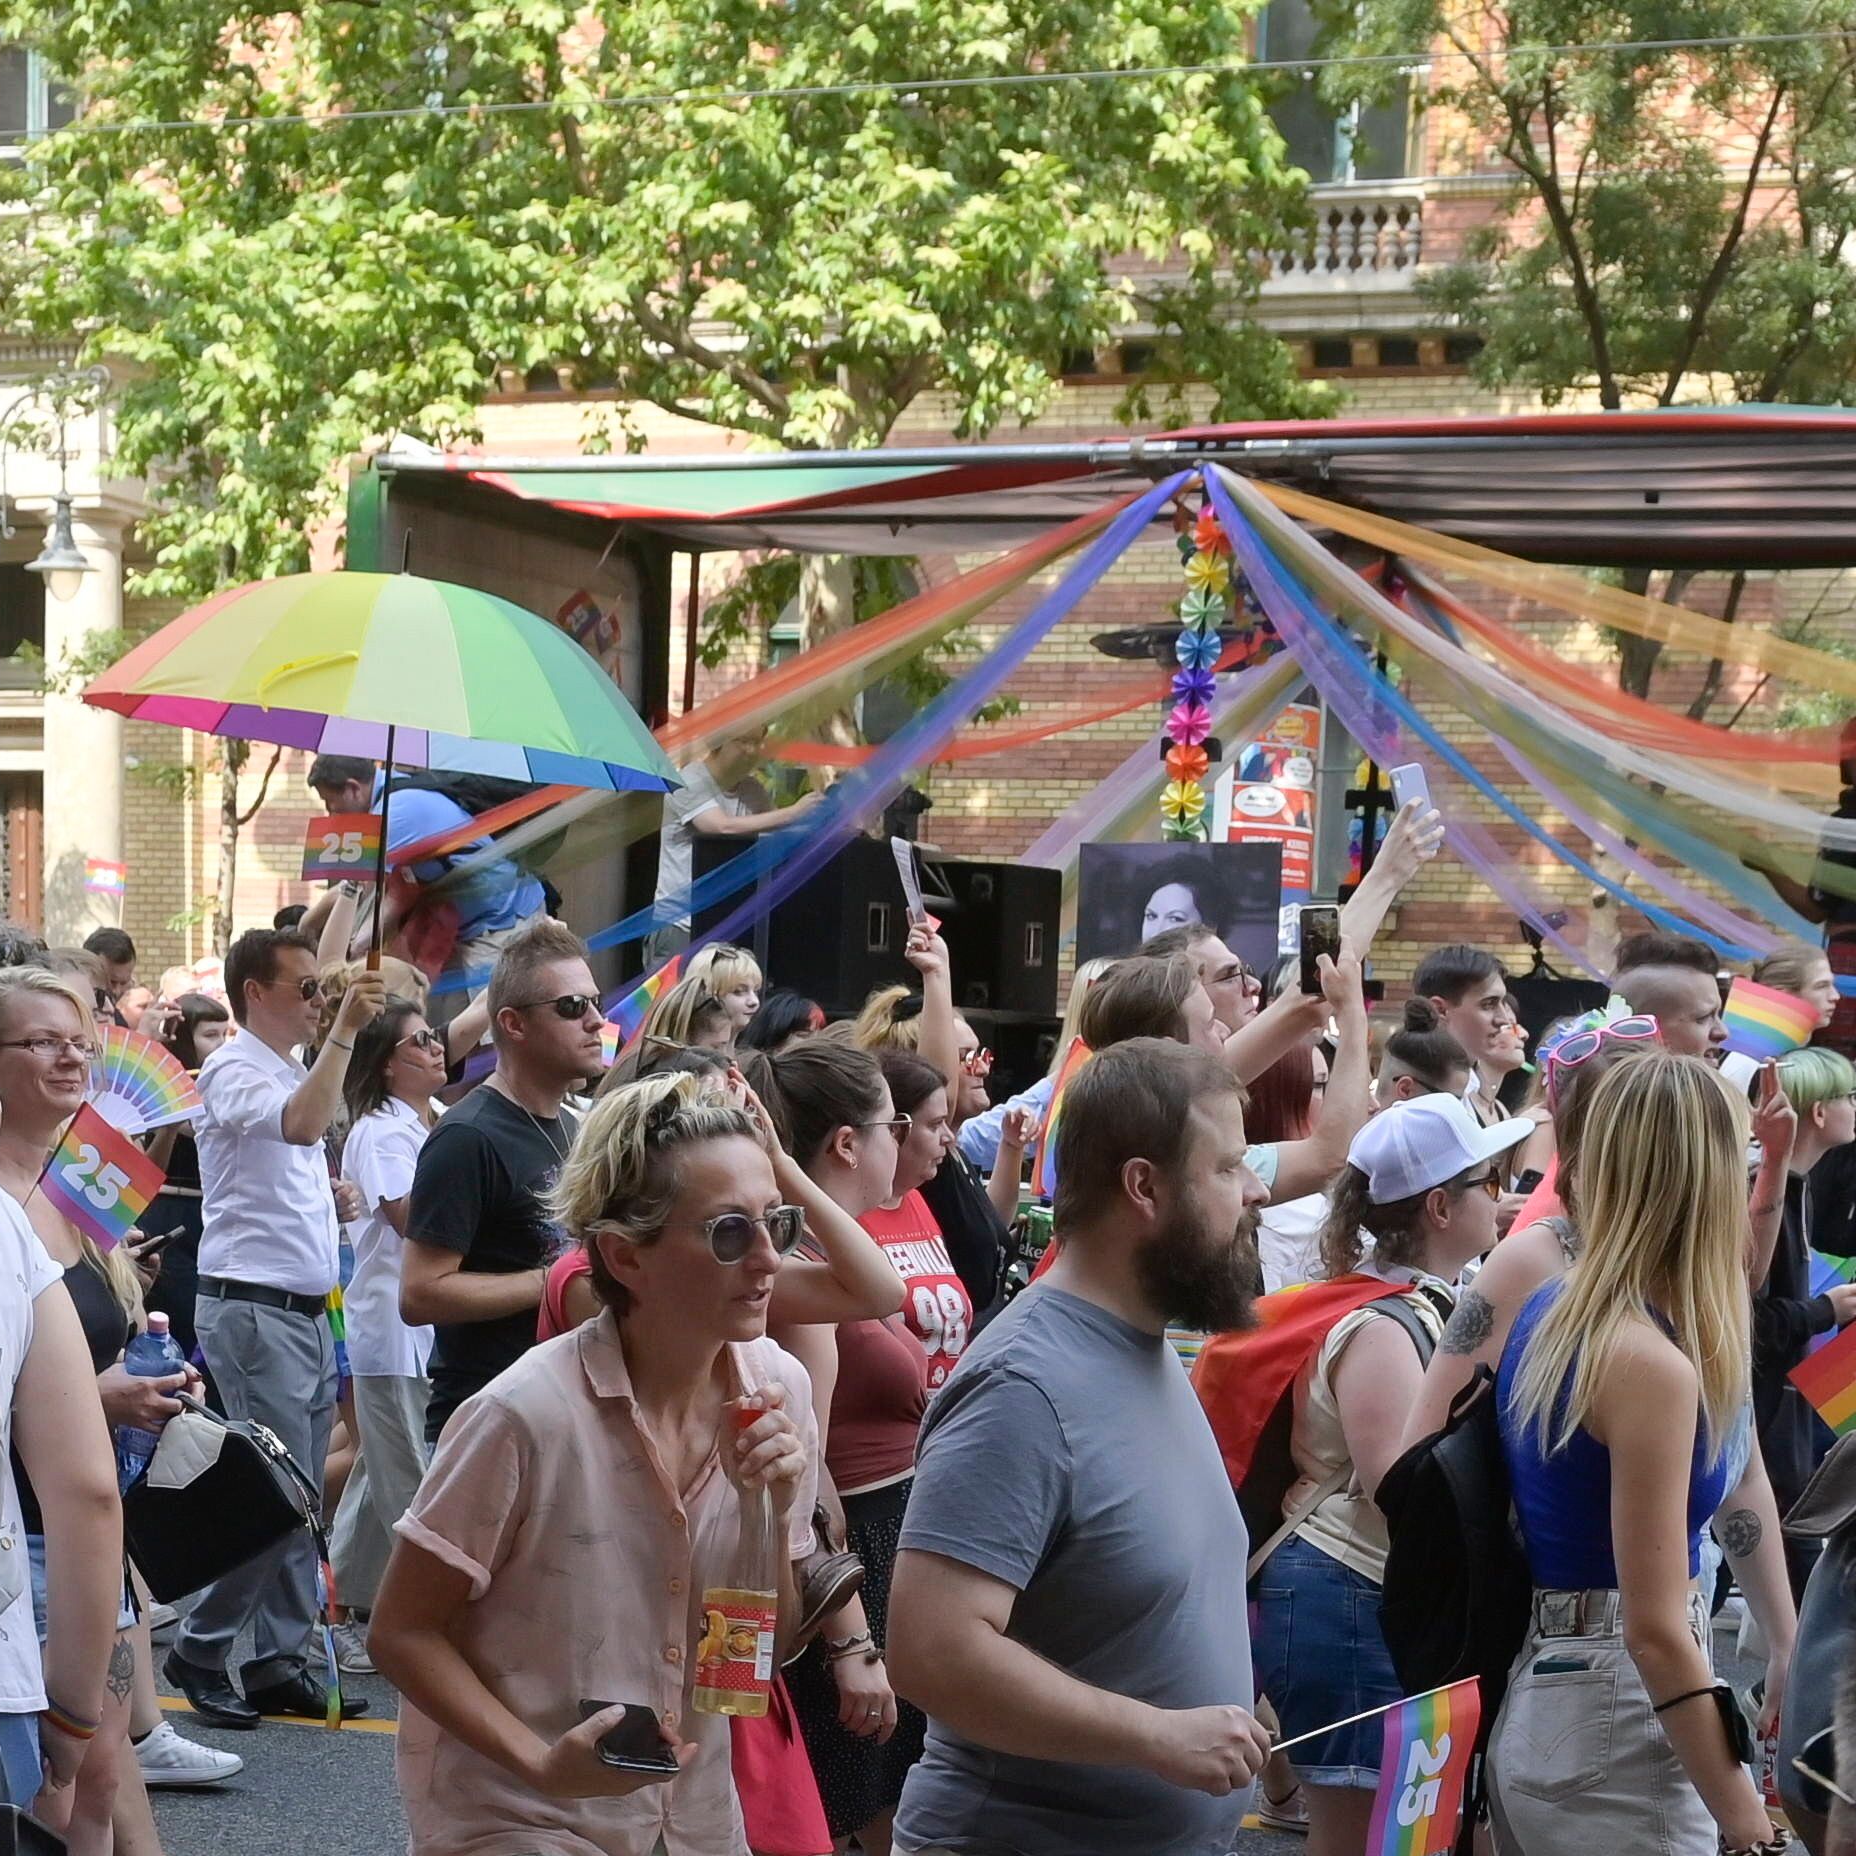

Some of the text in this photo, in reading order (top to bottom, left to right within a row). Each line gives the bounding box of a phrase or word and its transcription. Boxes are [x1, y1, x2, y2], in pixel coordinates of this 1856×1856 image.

[318, 831, 363, 863] 25
[60, 1143, 131, 1210] 25
[912, 1283, 969, 1358] 98
[1396, 1732, 1452, 1827] 25
